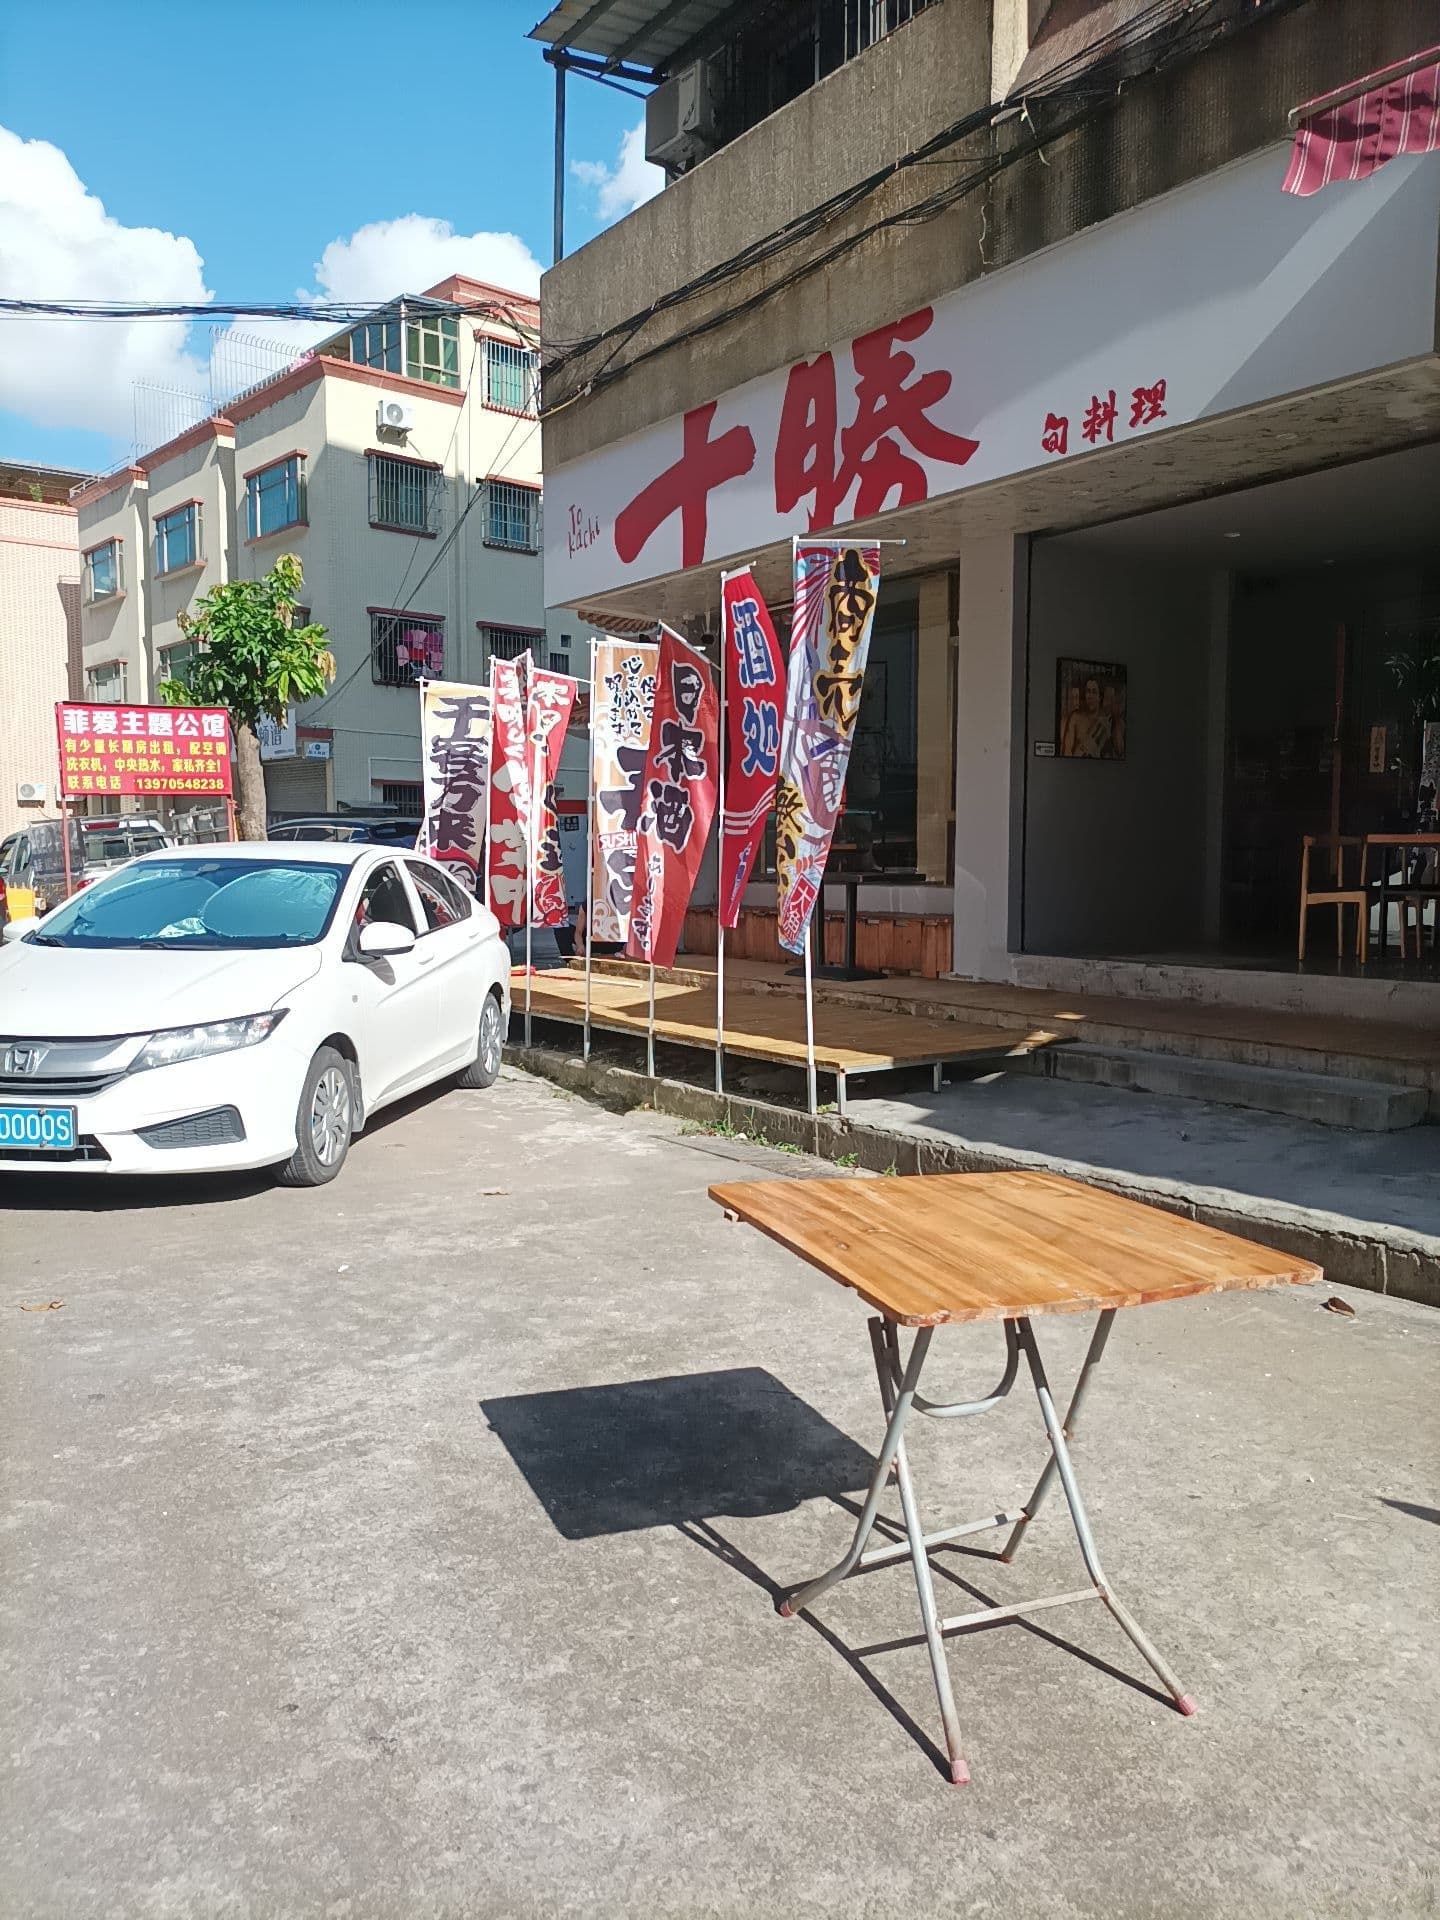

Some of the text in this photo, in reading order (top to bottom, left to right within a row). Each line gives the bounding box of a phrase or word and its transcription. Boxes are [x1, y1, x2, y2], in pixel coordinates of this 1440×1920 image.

[1042, 378, 1167, 455] 旬料理
[63, 709, 225, 737] 菲爱主题公馆
[67, 775, 224, 790] 联系电话 13970548238
[638, 662, 707, 854] 日本酒
